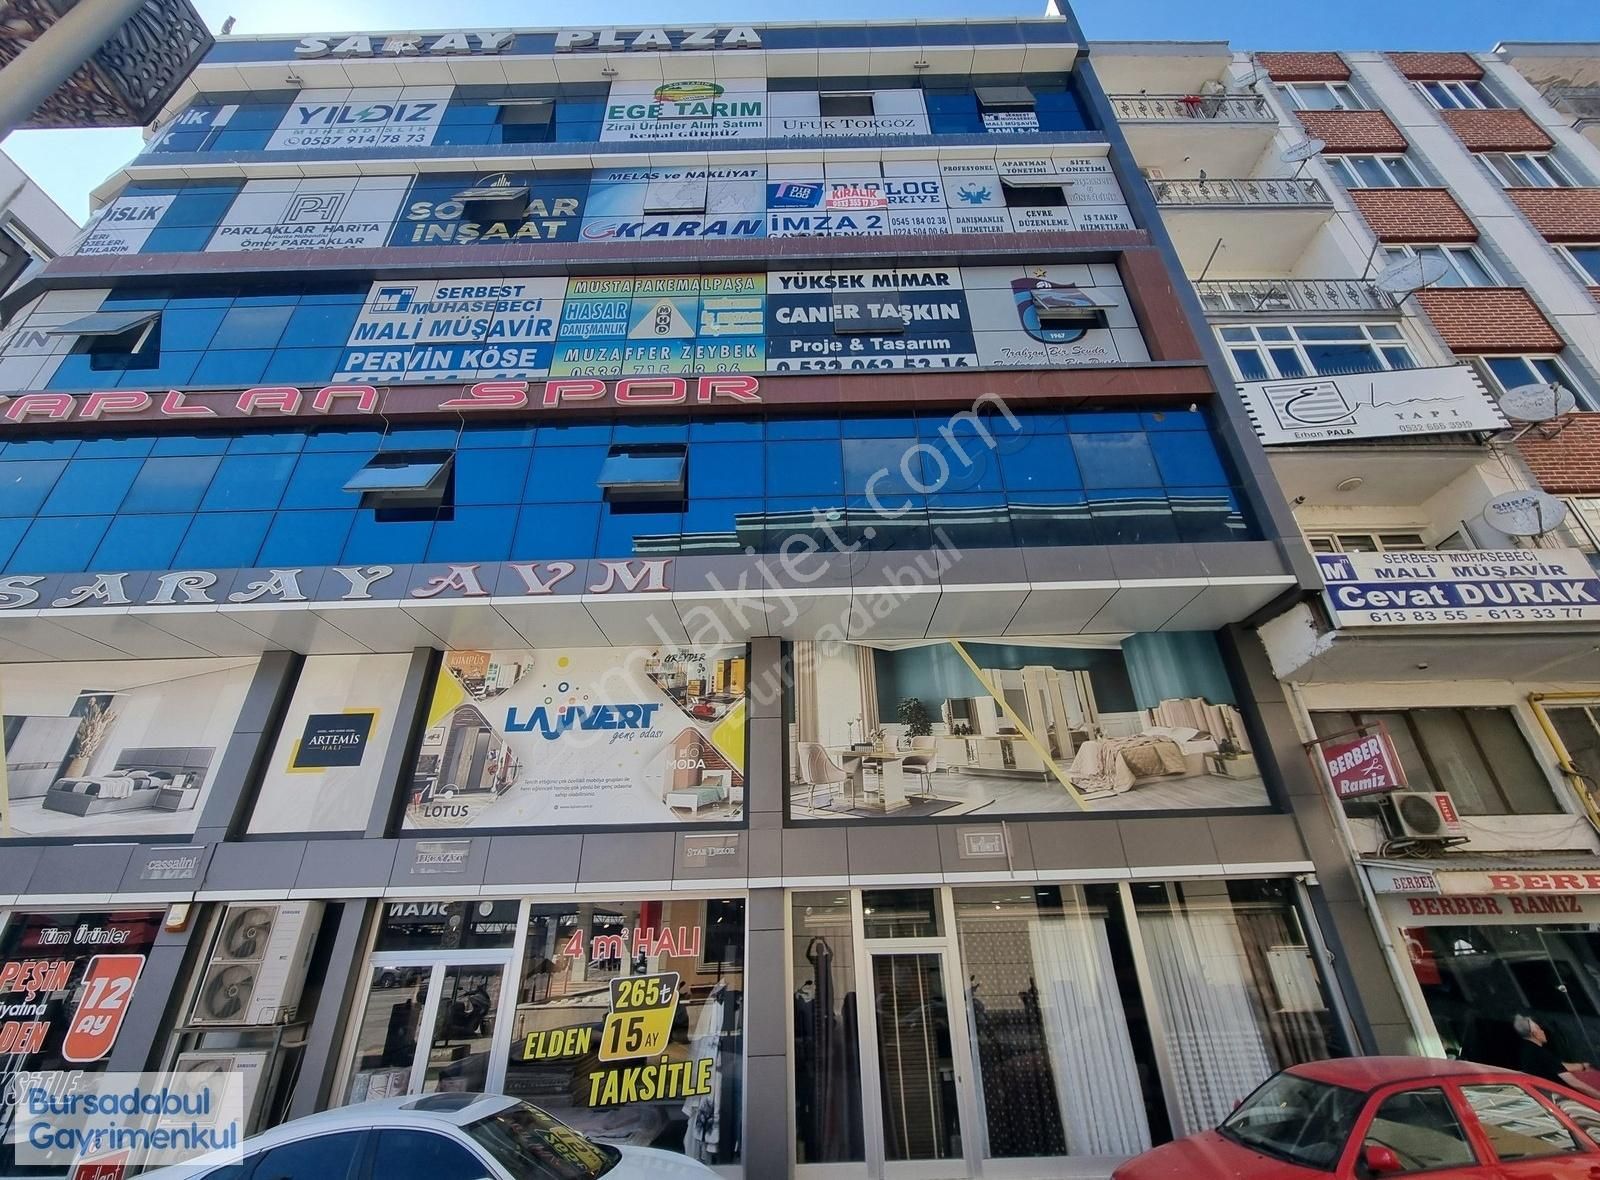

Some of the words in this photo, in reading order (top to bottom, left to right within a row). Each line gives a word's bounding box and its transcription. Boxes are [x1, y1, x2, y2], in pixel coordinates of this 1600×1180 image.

[294, 31, 514, 58] SARAY
[554, 26, 762, 51] PLAZA
[298, 103, 437, 125] YILDIZ
[608, 103, 664, 120] EGE
[673, 101, 762, 117] TARIM
[605, 122, 635, 132] Zirai
[640, 121, 687, 131] Ürünler
[690, 120, 718, 130] Alım
[722, 119, 763, 129] Satımı
[783, 119, 836, 131] UFUK
[301, 135, 341, 146] 0537
[346, 134, 375, 145] 914
[381, 134, 400, 144] 78
[406, 133, 425, 144] 73
[685, 169, 759, 179] NAKLİYAT
[943, 164, 994, 172] PROFESYONEL
[771, 214, 857, 231] İMZA
[866, 215, 883, 230] 2
[891, 217, 909, 226] 0545
[911, 217, 925, 226] 184
[926, 217, 937, 225] 02
[938, 216, 947, 225] 38
[956, 215, 1005, 225] DANIŞMANLIK
[1018, 219, 1069, 228] DÜZENLEME
[1025, 210, 1053, 218] ÇEVRE
[220, 225, 315, 237] PARLAKLAR
[322, 223, 380, 234] HARİTA
[410, 220, 567, 245] İNŞAAT
[613, 219, 763, 238] KARAN
[241, 237, 278, 248] Ömer
[280, 236, 365, 247] PARLAKLAR
[574, 277, 755, 294] MUSTAFAKEMALPAŞA
[779, 271, 865, 290] YÜKSEK
[872, 269, 950, 288] MİMAR
[436, 285, 526, 299] SERBEST
[565, 301, 628, 321] HASAR
[775, 304, 861, 324] CANER
[866, 303, 960, 326] TAŞKIN
[354, 317, 423, 341] MALİ
[429, 314, 553, 341] MÜŞAVİR
[560, 321, 627, 339] DANIŞMANLIK
[564, 344, 671, 362] MUZAFFER
[680, 343, 757, 360] ZEYBEK
[790, 340, 842, 356] Proje
[850, 338, 865, 351] &
[869, 338, 950, 351] Tasarım
[344, 346, 453, 371] PERVİN
[460, 346, 537, 368] KÖSE
[438, 375, 762, 410] SPOR
[1294, 431, 1324, 439] Erhan
[1327, 429, 1354, 437] PALA
[1383, 552, 1444, 565] SERBEST
[1375, 563, 1437, 579] MALİ
[1453, 561, 1568, 579] MÜŞAVİR
[0, 565, 393, 609] SARAY
[410, 559, 672, 598] AVM
[1337, 585, 1450, 608] Cevat
[1455, 582, 1598, 605] DURAK
[1370, 610, 1406, 623] 613
[1413, 610, 1437, 622] 83
[1444, 609, 1468, 621] 55
[1488, 608, 1522, 620] 613
[1531, 608, 1556, 619] 33
[1560, 607, 1583, 618] 77
[308, 732, 361, 746] ARTEMİS
[609, 731, 636, 745] genç
[639, 726, 664, 739] odası
[666, 759, 706, 770] MODA
[1328, 737, 1381, 778] BERBER
[1341, 772, 1386, 794] Ramiz
[424, 805, 469, 818] LOTUS
[1392, 875, 1435, 890] BERBER
[1407, 896, 1503, 916] BERBER
[1507, 894, 1583, 915] RAMİZ
[38, 928, 72, 945] Tüm
[73, 924, 131, 945] Ürünler
[562, 928, 584, 959] 4
[631, 926, 701, 959] HALI
[0, 959, 75, 1001] PEŞİN
[83, 976, 132, 1009] 12
[522, 1026, 592, 1061] ELDEN
[609, 1016, 645, 1054] 15
[644, 1032, 659, 1048] AY
[588, 1055, 713, 1108] TAKSİTLE
